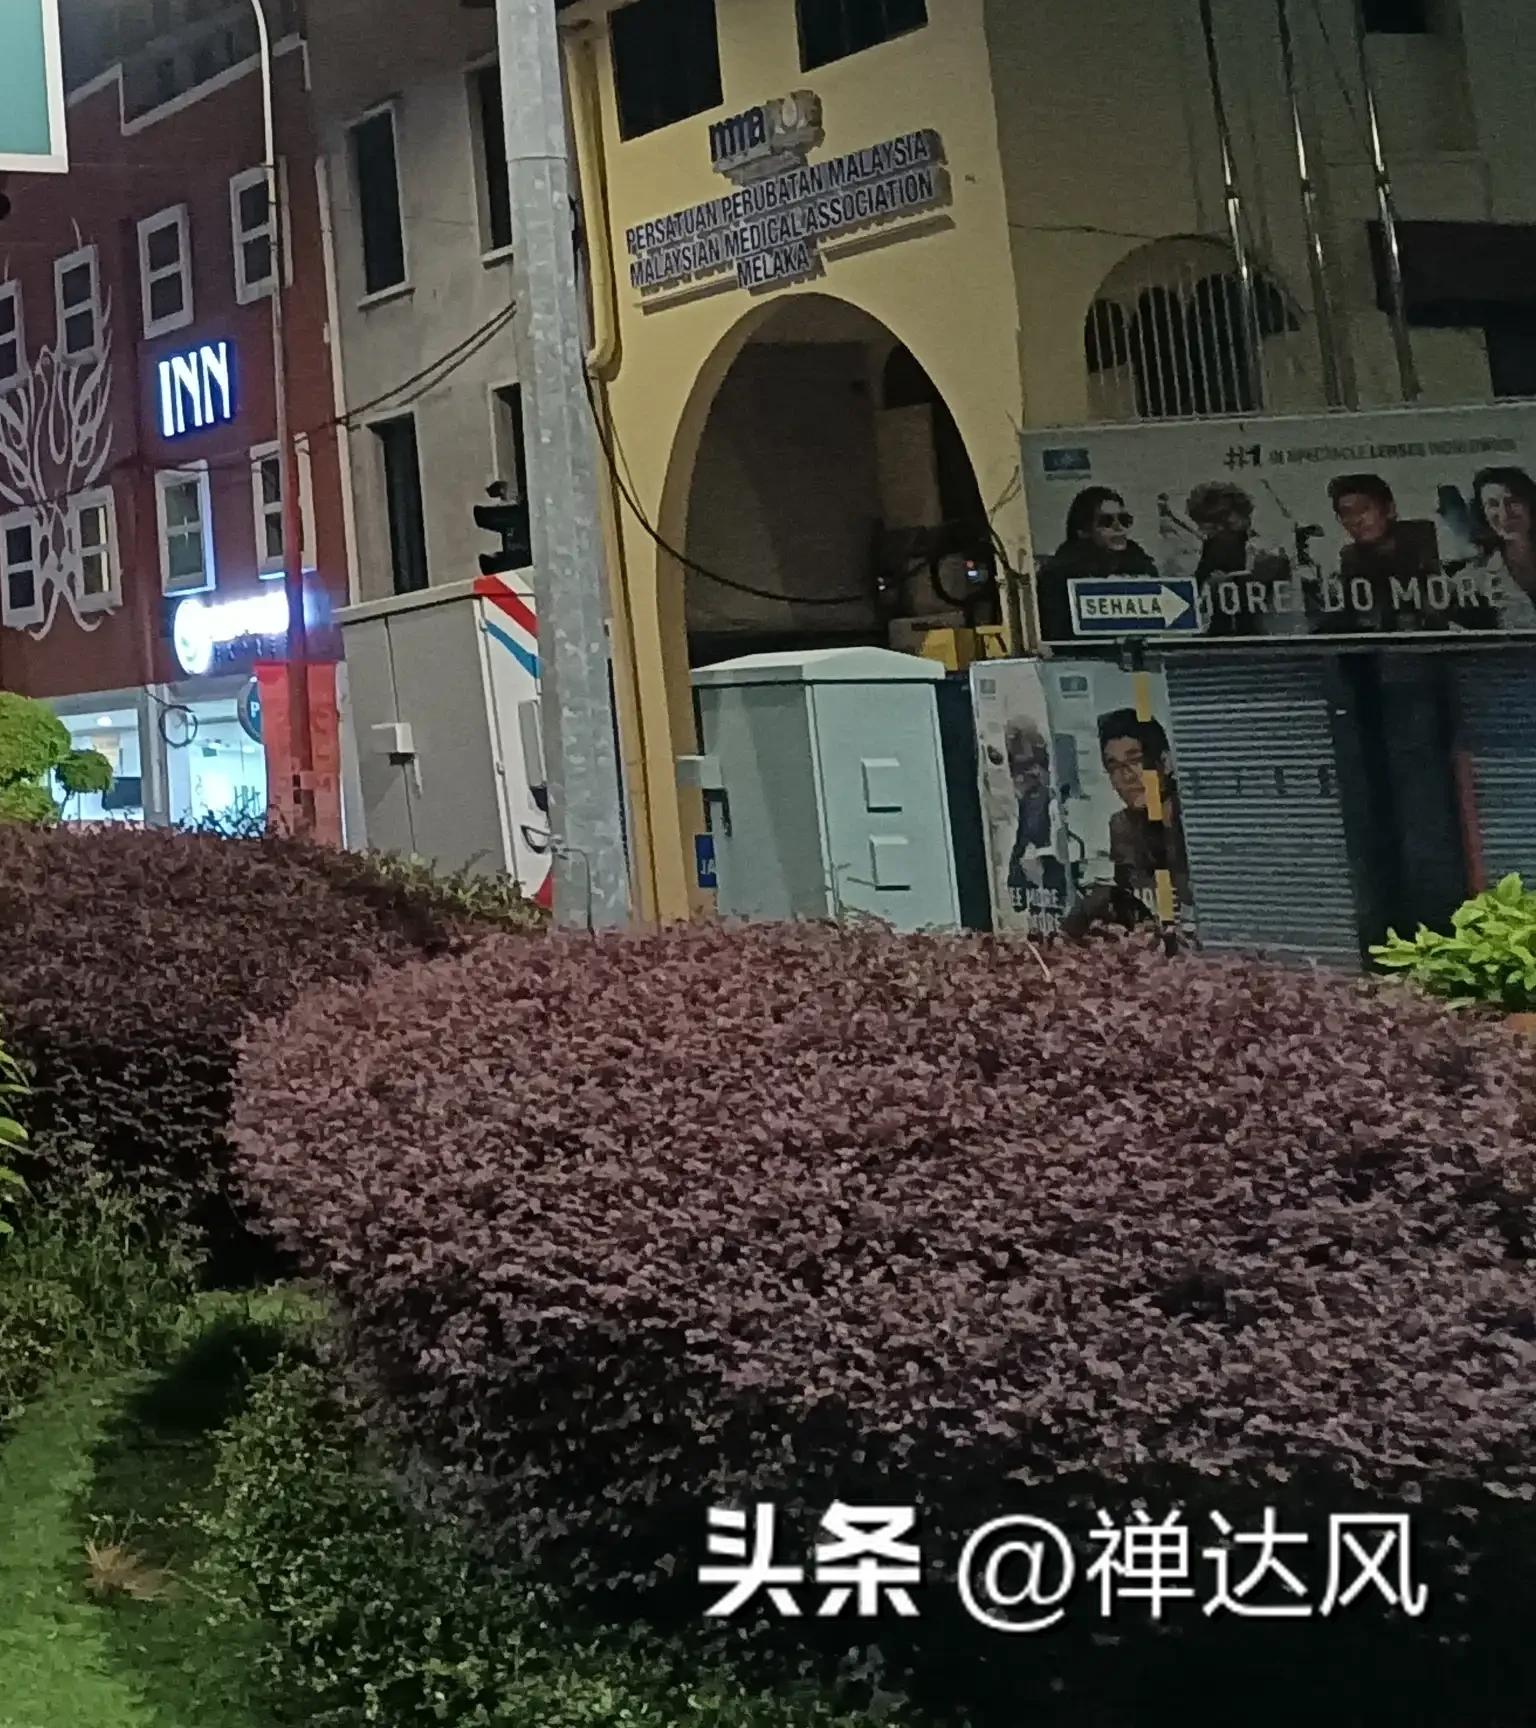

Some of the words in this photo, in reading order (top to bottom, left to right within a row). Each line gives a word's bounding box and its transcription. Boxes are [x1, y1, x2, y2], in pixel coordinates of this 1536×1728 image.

[625, 200, 718, 255] PERSATUAN
[722, 168, 824, 223] PERUBATAN
[828, 130, 929, 186] MALAYSIA
[630, 233, 721, 289] MALAYSIAN
[724, 210, 803, 260] MEDICAL
[806, 169, 934, 235] ASSOCIATION
[736, 241, 810, 289] MELAKA
[158, 341, 231, 438] INN
[1085, 594, 1163, 618] SEHALA
[1390, 573, 1507, 610] MORE
